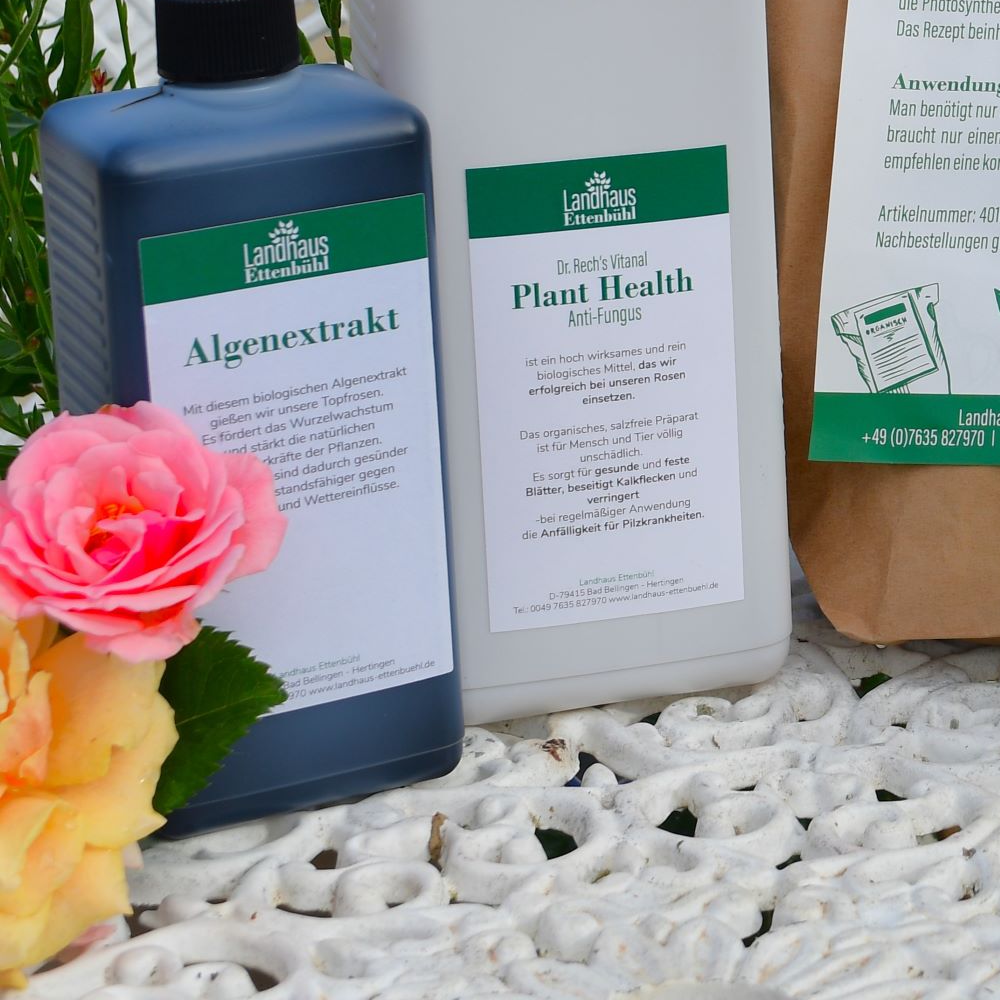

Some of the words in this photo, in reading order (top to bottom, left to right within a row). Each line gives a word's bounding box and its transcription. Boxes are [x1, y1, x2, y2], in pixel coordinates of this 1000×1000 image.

[886, 125, 935, 143] braucht
[940, 130, 962, 143] nur
[883, 152, 950, 173] empfehlen
[953, 152, 980, 170] eine
[563, 188, 636, 212] Landhaus
[563, 206, 636, 226] Ettenbühl
[877, 204, 975, 223] Artikelnummer:
[243, 236, 329, 268] Landhaus
[875, 230, 988, 253] Nachbestellungen
[244, 256, 329, 284] Ettenbühl
[556, 259, 570, 275] Dr.
[573, 255, 607, 273] Rech's
[610, 250, 647, 269] Vitanal
[511, 283, 590, 310] Plant
[598, 268, 694, 302] Health
[568, 307, 642, 328] Anti-Fungus
[184, 307, 399, 369] Algenextrakt
[524, 357, 538, 366] ist
[540, 355, 556, 365] ein
[558, 352, 584, 363] hoch
[586, 347, 642, 360] wirksames
[645, 342, 664, 354] und
[667, 340, 686, 352] rein
[536, 366, 601, 381] biologisches
[638, 359, 656, 369] das
[659, 356, 676, 367] wir
[182, 403, 203, 416] Mit
[205, 397, 249, 412] diesem
[252, 382, 328, 404] biologischen
[331, 366, 406, 389] Algenextrakt
[528, 381, 586, 395] erfolgreich
[589, 378, 605, 389] bei
[608, 376, 650, 387] unseren
[653, 371, 685, 382] Rosen
[209, 413, 252, 429] gießen
[254, 406, 274, 419] wir
[277, 400, 318, 415] unsere
[323, 389, 383, 407] Topfrosen.
[582, 392, 635, 404] einsetzen.
[862, 427, 886, 443] +49
[890, 426, 937, 447] (0)7635
[940, 429, 984, 445] 827970
